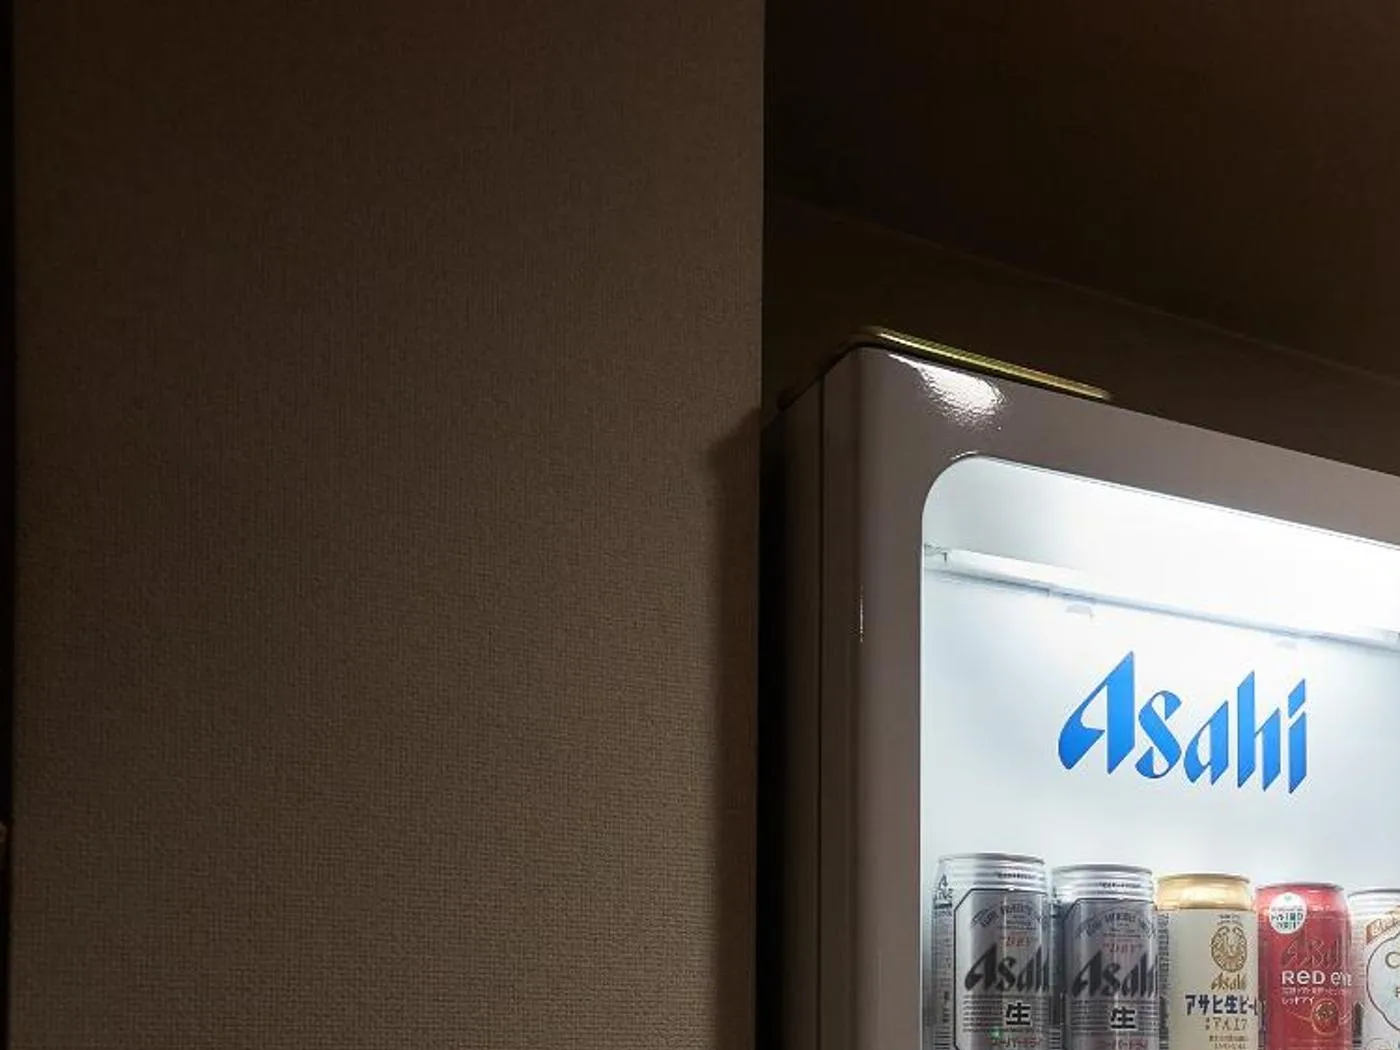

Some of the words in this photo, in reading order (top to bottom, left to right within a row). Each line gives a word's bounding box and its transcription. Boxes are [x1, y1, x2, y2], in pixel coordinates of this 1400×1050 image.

[1058, 650, 1308, 794] Asahi
[964, 944, 1050, 992] Asah
[1005, 1002, 1031, 1027] 生
[1110, 1006, 1136, 1030] 生
